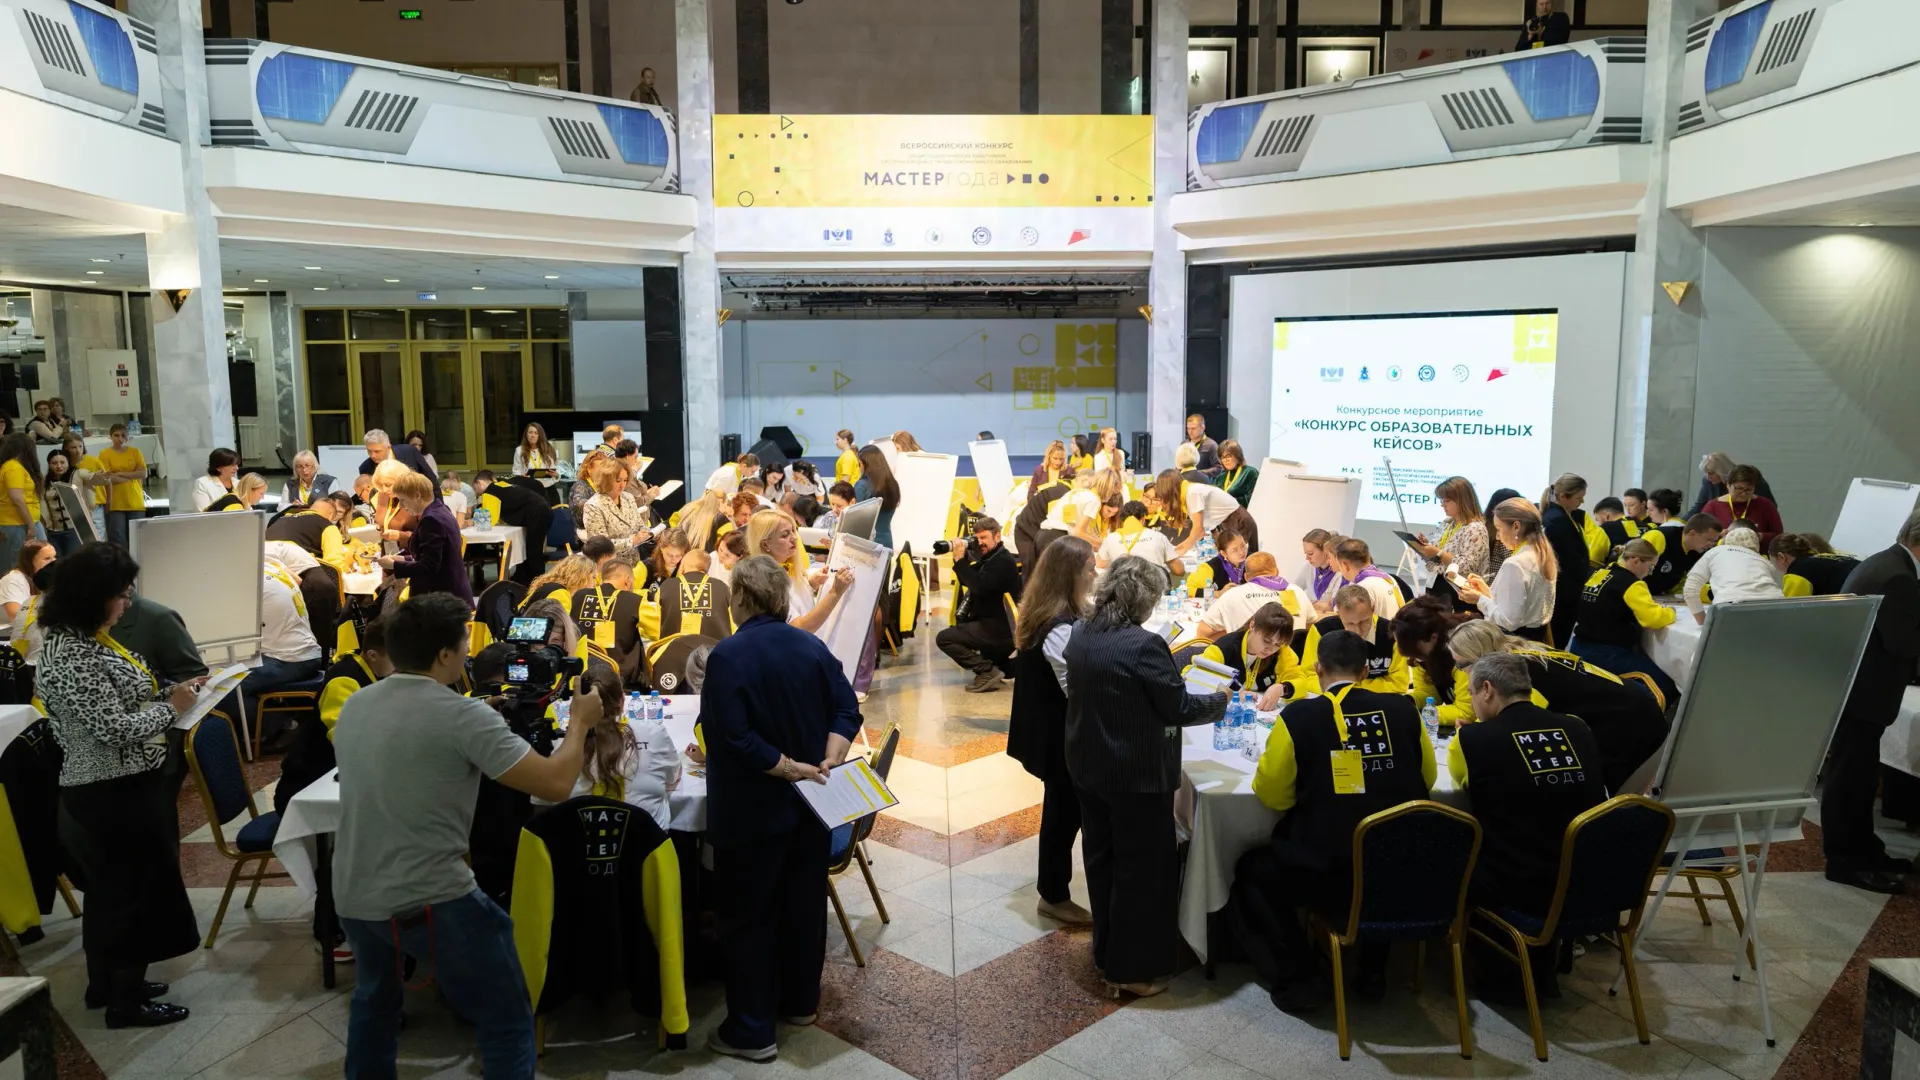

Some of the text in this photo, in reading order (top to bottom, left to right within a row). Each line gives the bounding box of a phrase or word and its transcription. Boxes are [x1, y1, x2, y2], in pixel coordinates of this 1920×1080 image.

[900, 142, 1014, 150] ВСЕРОССИЙСКИЙ КОНКУРС
[1336, 404, 1484, 418] Конкурсное мероприятие
[1294, 419, 1534, 436] «КОНКУРС ОБРАЗОВАТЕЛЬНЫХ
[1373, 436, 1442, 451] КЕЙСОВ»
[1518, 732, 1563, 744] МАС
[1245, 747, 1252, 757] 14
[1532, 756, 1574, 769] ТЕР
[583, 811, 624, 822] МАС
